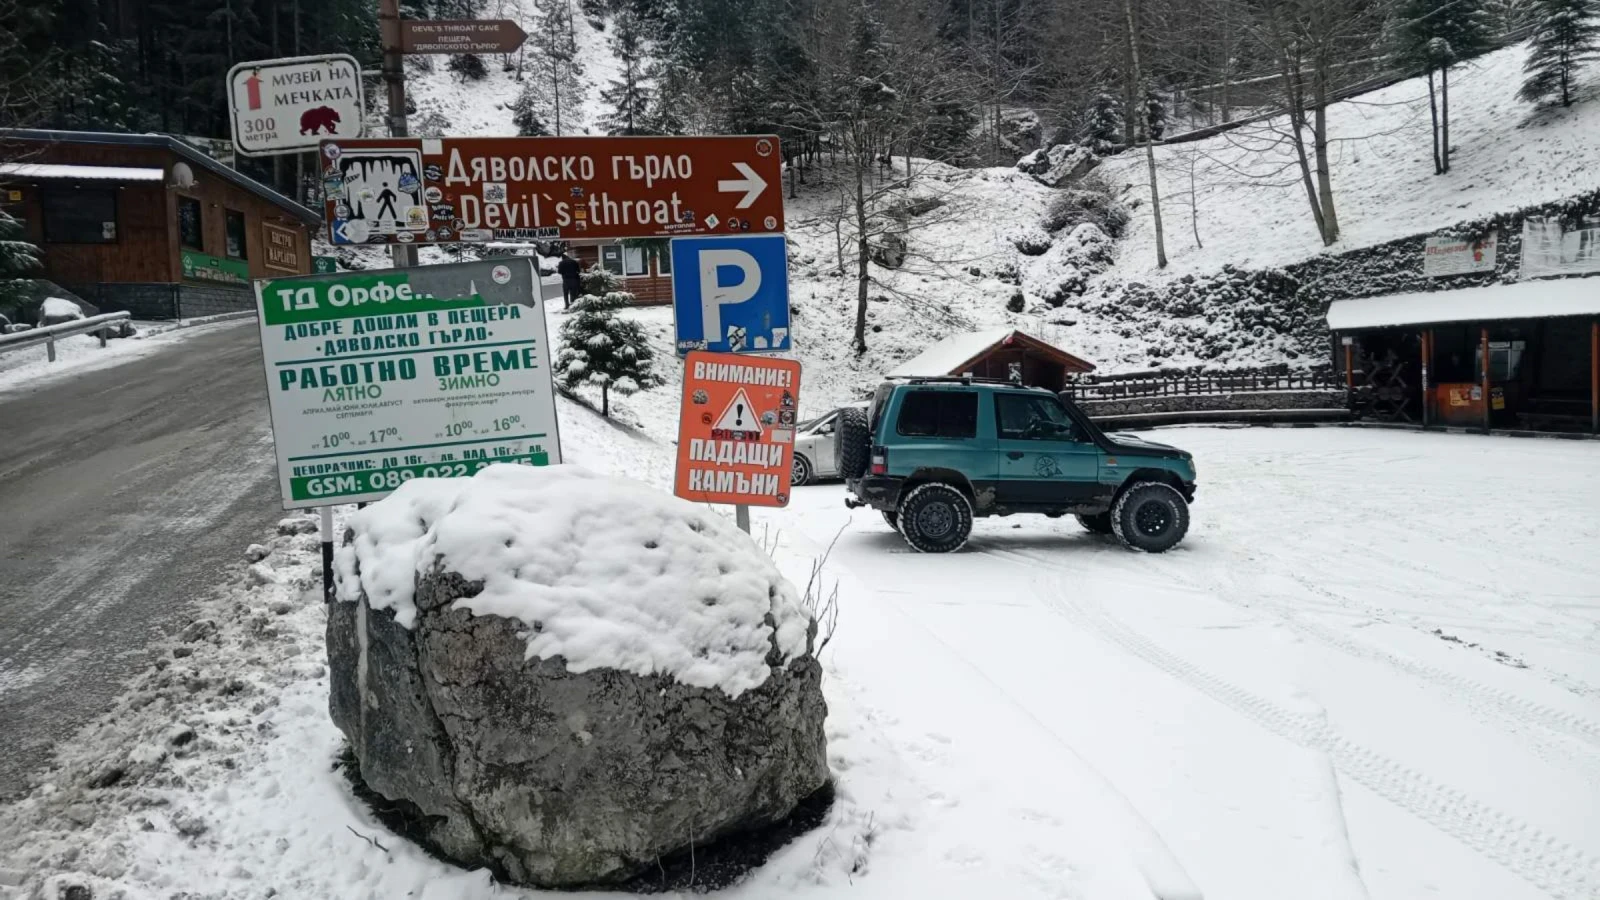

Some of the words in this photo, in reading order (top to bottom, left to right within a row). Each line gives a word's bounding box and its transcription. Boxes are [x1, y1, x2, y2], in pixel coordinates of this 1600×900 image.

[272, 68, 321, 87] МУЗЕЙ
[329, 67, 351, 80] НА
[274, 86, 353, 106] МЕЧКАТА
[244, 118, 276, 134] 300
[245, 130, 278, 142] метра
[445, 148, 595, 187] Дяволско
[612, 154, 692, 188] гърло
[588, 192, 682, 226] throat
[495, 228, 516, 238] HANK
[516, 228, 538, 238] HANK
[540, 226, 559, 236] HANK
[276, 286, 320, 311] ТД
[698, 249, 762, 342] P
[284, 320, 343, 341] ДОБРЕ
[353, 314, 418, 335] ДОШЛИ
[428, 312, 439, 326] В
[448, 306, 520, 324] ПЕЩЕРА
[280, 358, 416, 391] РАБОТНО
[433, 348, 538, 376] ВРЕМЕ
[694, 362, 792, 388] ВНИМАНИЕ!
[322, 384, 382, 402] ЛЯТНО
[439, 373, 500, 391] ЗИМНО
[383, 457, 398, 469] ДО
[463, 448, 488, 460] НАД
[689, 438, 783, 469] ПАДАЩИ
[306, 476, 362, 496] GSM:
[688, 468, 780, 496] КАМЪНИ
